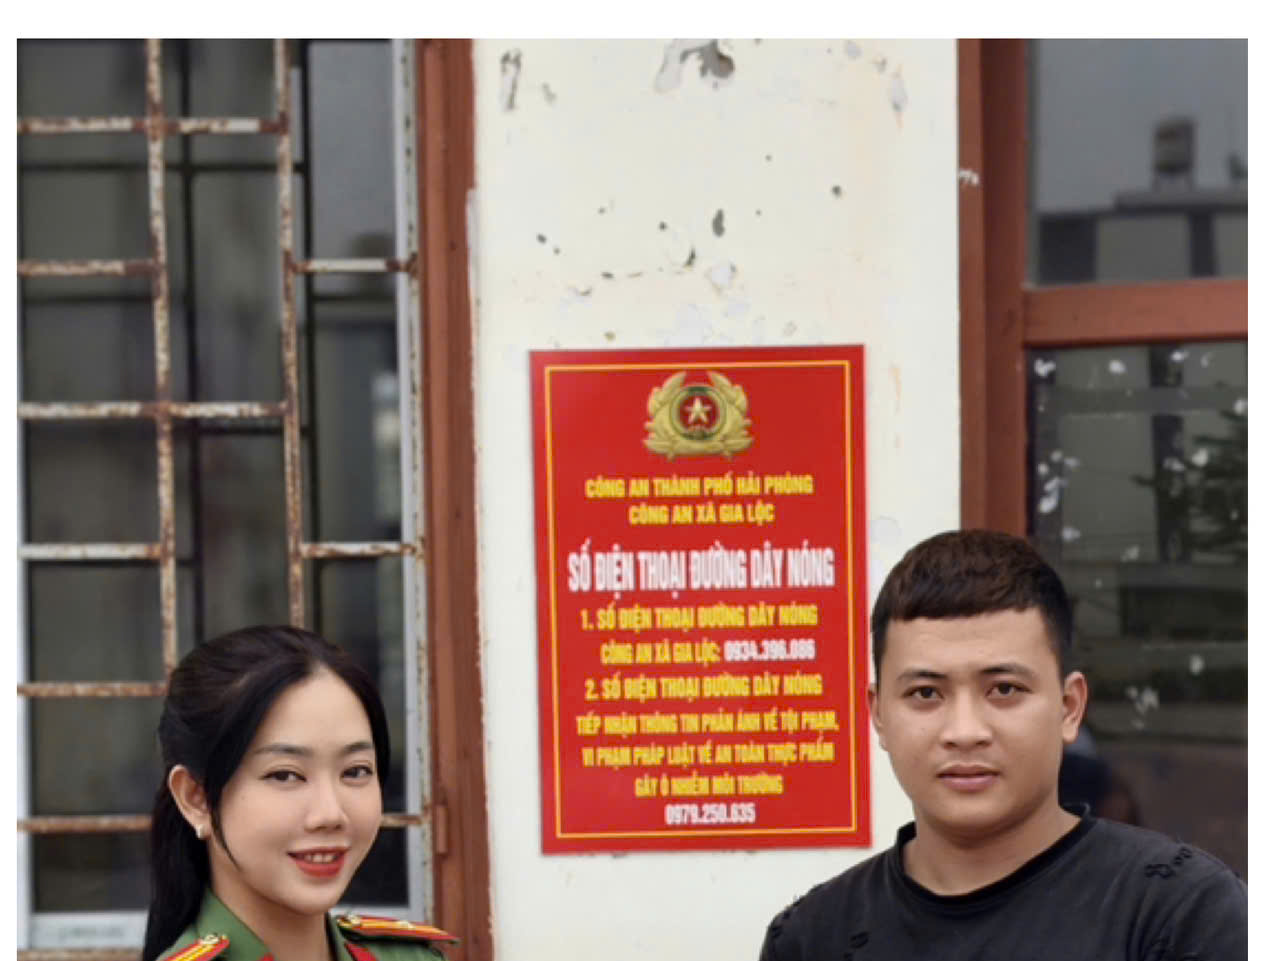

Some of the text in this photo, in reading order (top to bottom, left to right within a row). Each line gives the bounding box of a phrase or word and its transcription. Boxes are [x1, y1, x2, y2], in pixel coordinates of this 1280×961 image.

[585, 470, 813, 498] CÔNG AN THÀNH PHỐ HẢI PHÒNG
[629, 500, 775, 527] CÔNG AN XÃ GIA LỘC
[568, 538, 835, 600] SỐ ĐIỆN THOẠI ĐƯỜNG DÂY NÓNG
[581, 601, 818, 632] 1. SỐ ĐIỆN THOẠI ĐƯỜNG DÂY NÓNG
[585, 679, 599, 701] 2.
[602, 672, 621, 700] SỐ
[624, 674, 657, 703] ĐIỆN
[660, 677, 700, 703] THOẠI
